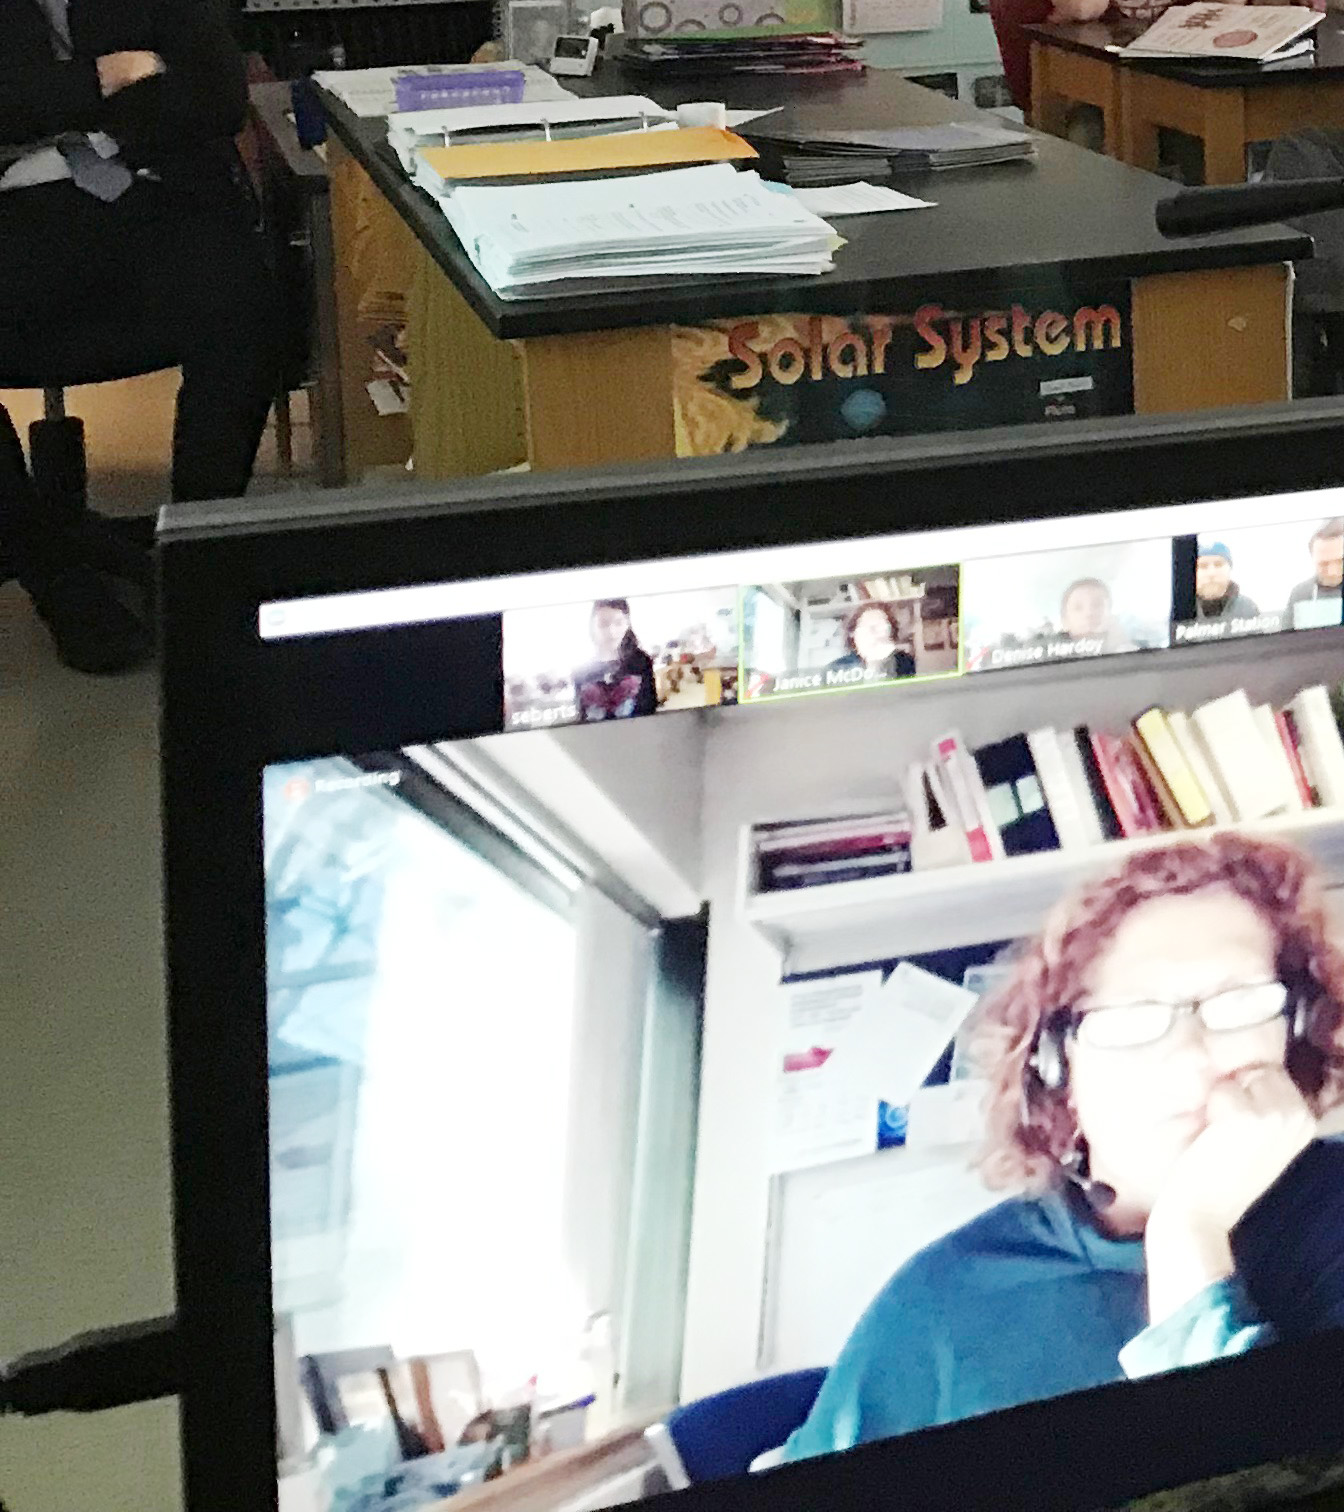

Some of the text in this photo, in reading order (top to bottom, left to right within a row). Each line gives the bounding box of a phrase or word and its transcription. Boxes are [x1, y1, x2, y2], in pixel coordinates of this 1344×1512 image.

[728, 302, 1122, 390] Solar System
[1175, 615, 1281, 641] Palmer Station
[990, 646, 1044, 665] Denise
[773, 672, 822, 692] Janice
